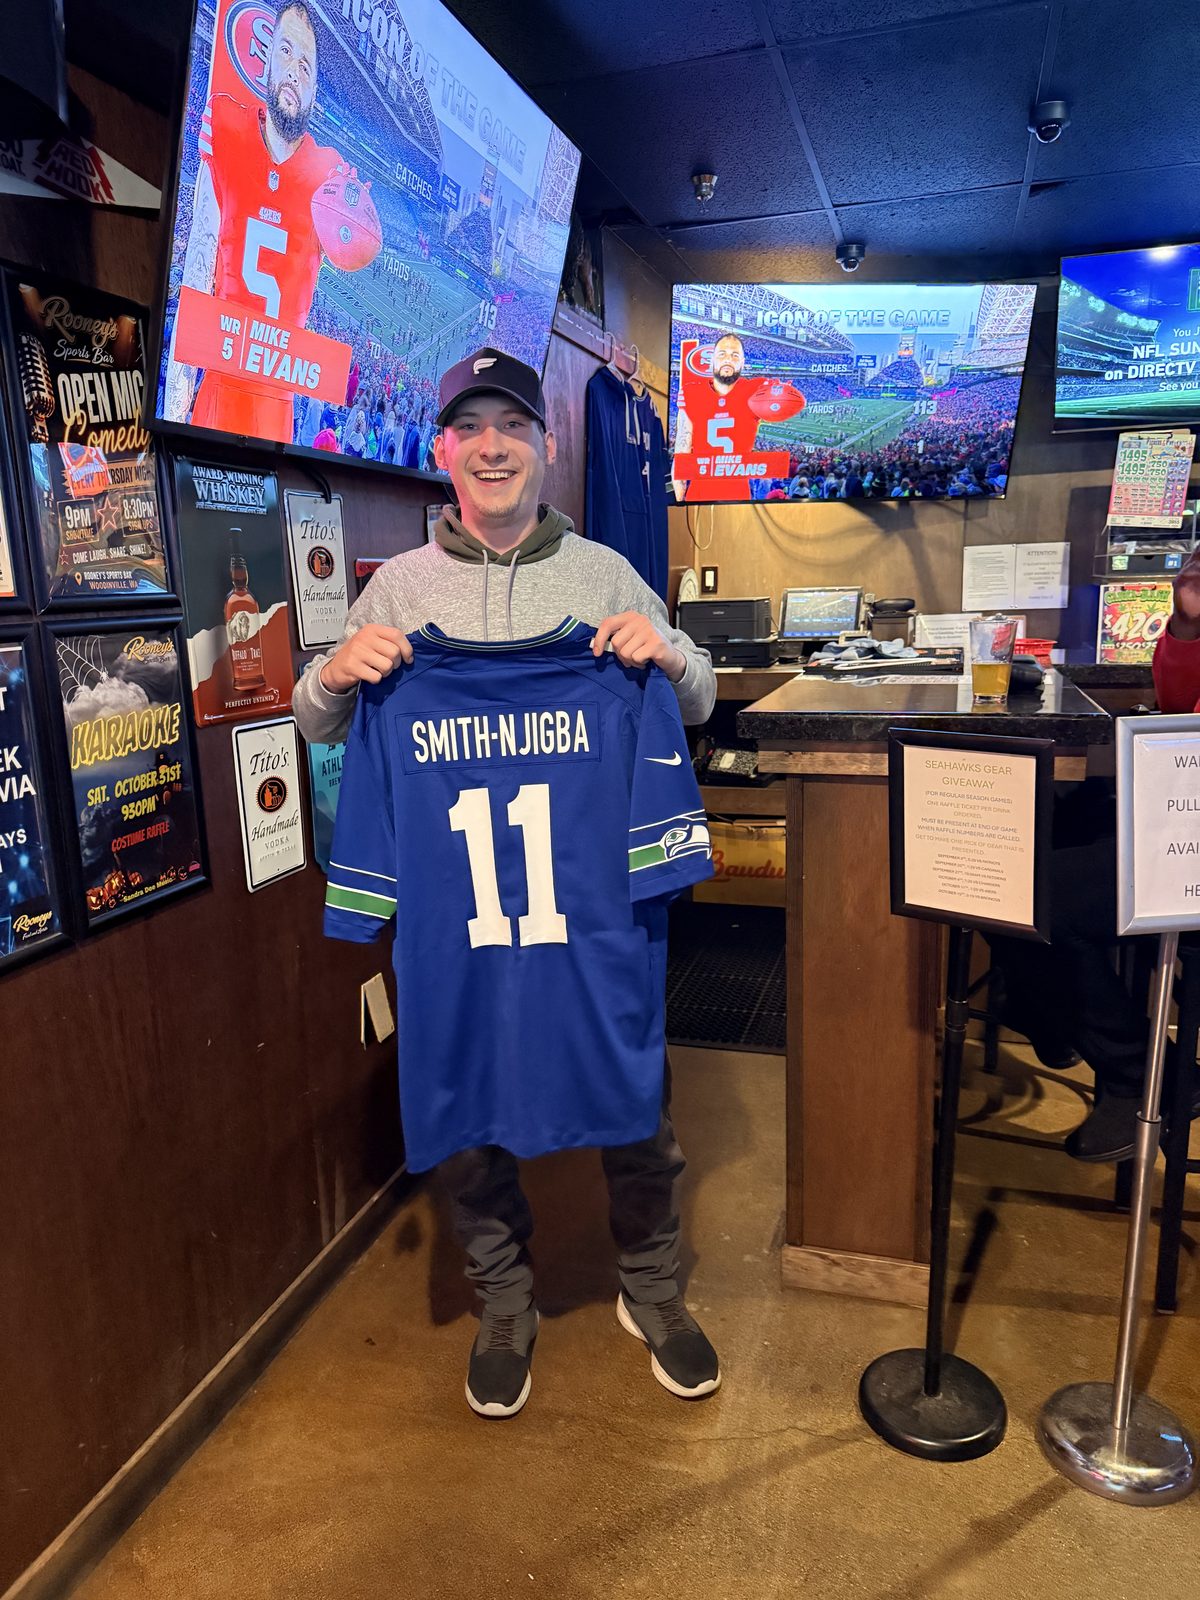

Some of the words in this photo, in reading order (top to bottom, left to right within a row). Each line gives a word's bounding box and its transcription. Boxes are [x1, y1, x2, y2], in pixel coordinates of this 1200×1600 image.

[410, 42, 439, 86] OF
[441, 67, 478, 132] THE
[479, 107, 527, 175] GAME
[54, 144, 97, 178] RED
[395, 163, 432, 201] CATCHES
[242, 217, 288, 320] 5
[383, 253, 410, 281] YARDS
[40, 296, 119, 348] Rooney's
[478, 299, 497, 330] 113
[757, 310, 811, 328] ICON
[812, 310, 842, 328] OF
[845, 309, 885, 327] THE
[889, 309, 952, 327] GAME
[220, 314, 241, 336] WR
[249, 320, 291, 349] MIKE
[1173, 328, 1191, 337] You
[54, 339, 90, 360] Sports
[92, 347, 114, 364] Bar
[1133, 345, 1164, 359] NFL
[222, 337, 234, 360] 5
[245, 343, 321, 390] EVANS
[811, 364, 847, 373] CATCHES
[926, 360, 935, 374] 7
[1104, 369, 1123, 381] on
[1128, 361, 1197, 379] DIRECTV
[1159, 382, 1178, 391] See
[1181, 381, 1199, 392] you
[57, 371, 112, 426] OPEN
[913, 401, 938, 415] 113
[808, 405, 834, 414] YARDS
[64, 409, 152, 467] Comedy
[707, 418, 735, 453] 5
[805, 446, 815, 454] TD
[917, 440, 924, 454] 1
[714, 463, 767, 476] EVANS
[715, 455, 742, 464] MIKE
[192, 466, 264, 486] AWARD-WINNING
[193, 479, 265, 507] WHISKEY
[65, 505, 91, 528] 9PM
[123, 498, 154, 519] 8:30PM
[300, 517, 336, 541] Tito's
[72, 551, 88, 564] COME
[106, 571, 123, 580] SPORTS
[302, 584, 345, 602] Handmade
[314, 607, 337, 615] VODKA
[123, 636, 174, 661] Rooney's
[225, 698, 252, 708] PERFECTLY
[252, 695, 274, 705] UNTAMED
[71, 703, 180, 770] KARAOKE
[412, 710, 590, 763] SMITH-NJIGBA
[250, 747, 289, 776] Tito's
[925, 760, 981, 773] SEAHAWKS
[984, 764, 1012, 775] GEAR
[87, 785, 110, 807] SAT.
[114, 770, 158, 798] OCTOBER
[942, 777, 995, 789] GIVEAWAY
[939, 791, 965, 799] REGULAR
[1168, 800, 1200, 812] PULL
[251, 810, 299, 842] Handmade
[917, 824, 935, 832] WHEN
[936, 826, 956, 834] RAFFLE
[957, 829, 984, 837] NUMBERS
[945, 820, 969, 828] PRESENT
[111, 829, 145, 853] COSTUME
[146, 820, 170, 839] RAFFLE
[264, 836, 289, 850] VODKA
[448, 783, 568, 949] 11
[144, 884, 156, 893] Dee
